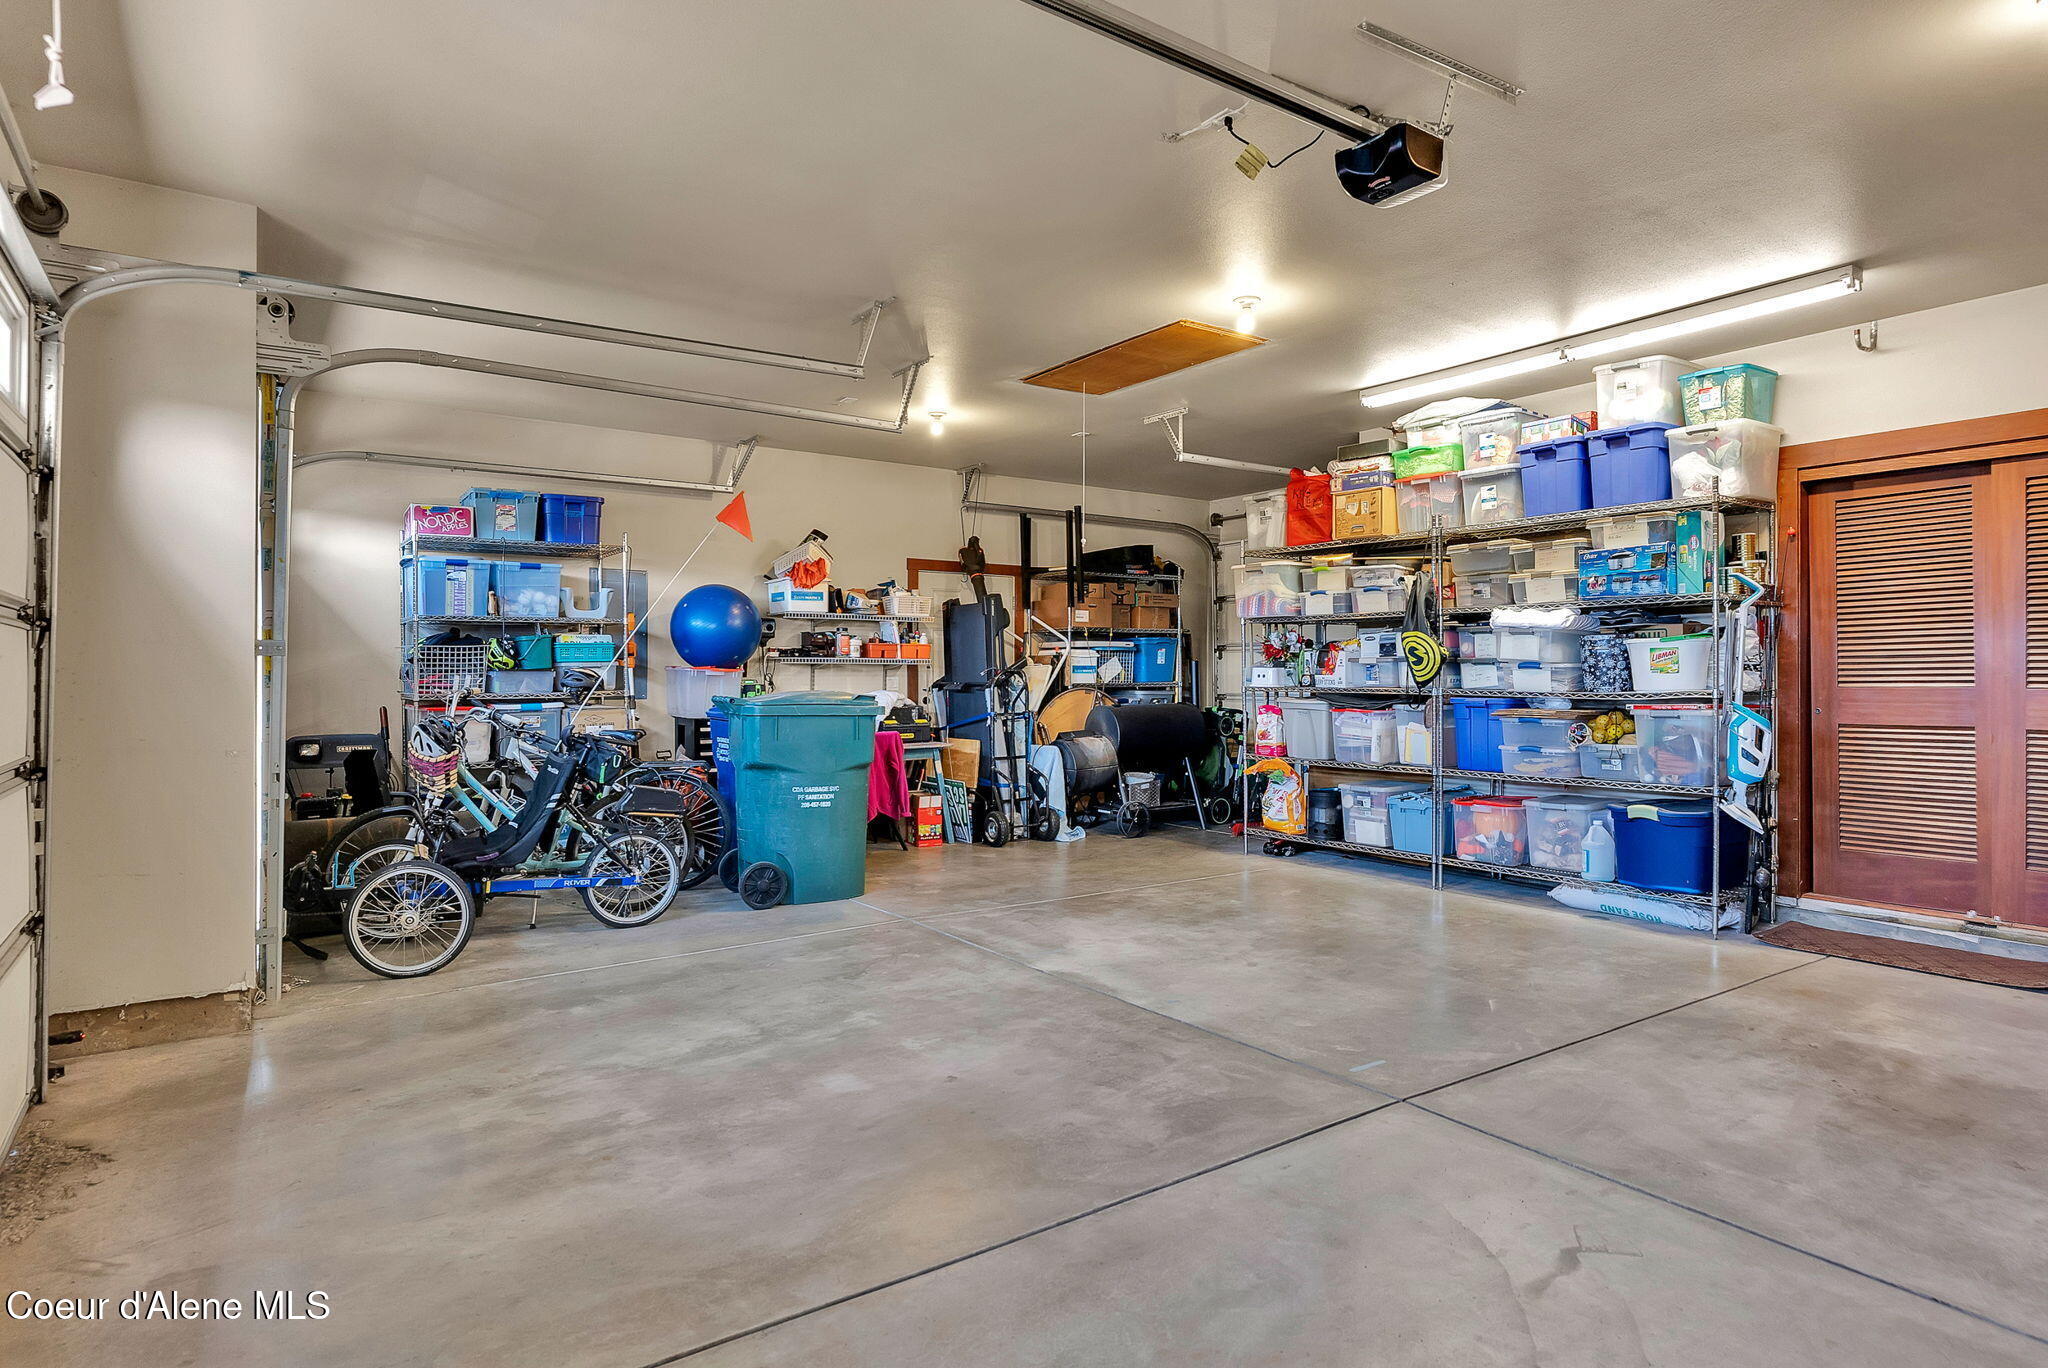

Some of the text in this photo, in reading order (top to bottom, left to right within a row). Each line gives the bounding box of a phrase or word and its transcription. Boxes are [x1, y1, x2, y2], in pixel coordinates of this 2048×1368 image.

[417, 510, 466, 530] NORDIC
[442, 522, 469, 532] APPLES
[1652, 650, 1677, 661] LIBMAN
[564, 879, 591, 887] ROVER
[1600, 904, 1630, 916] SAND
